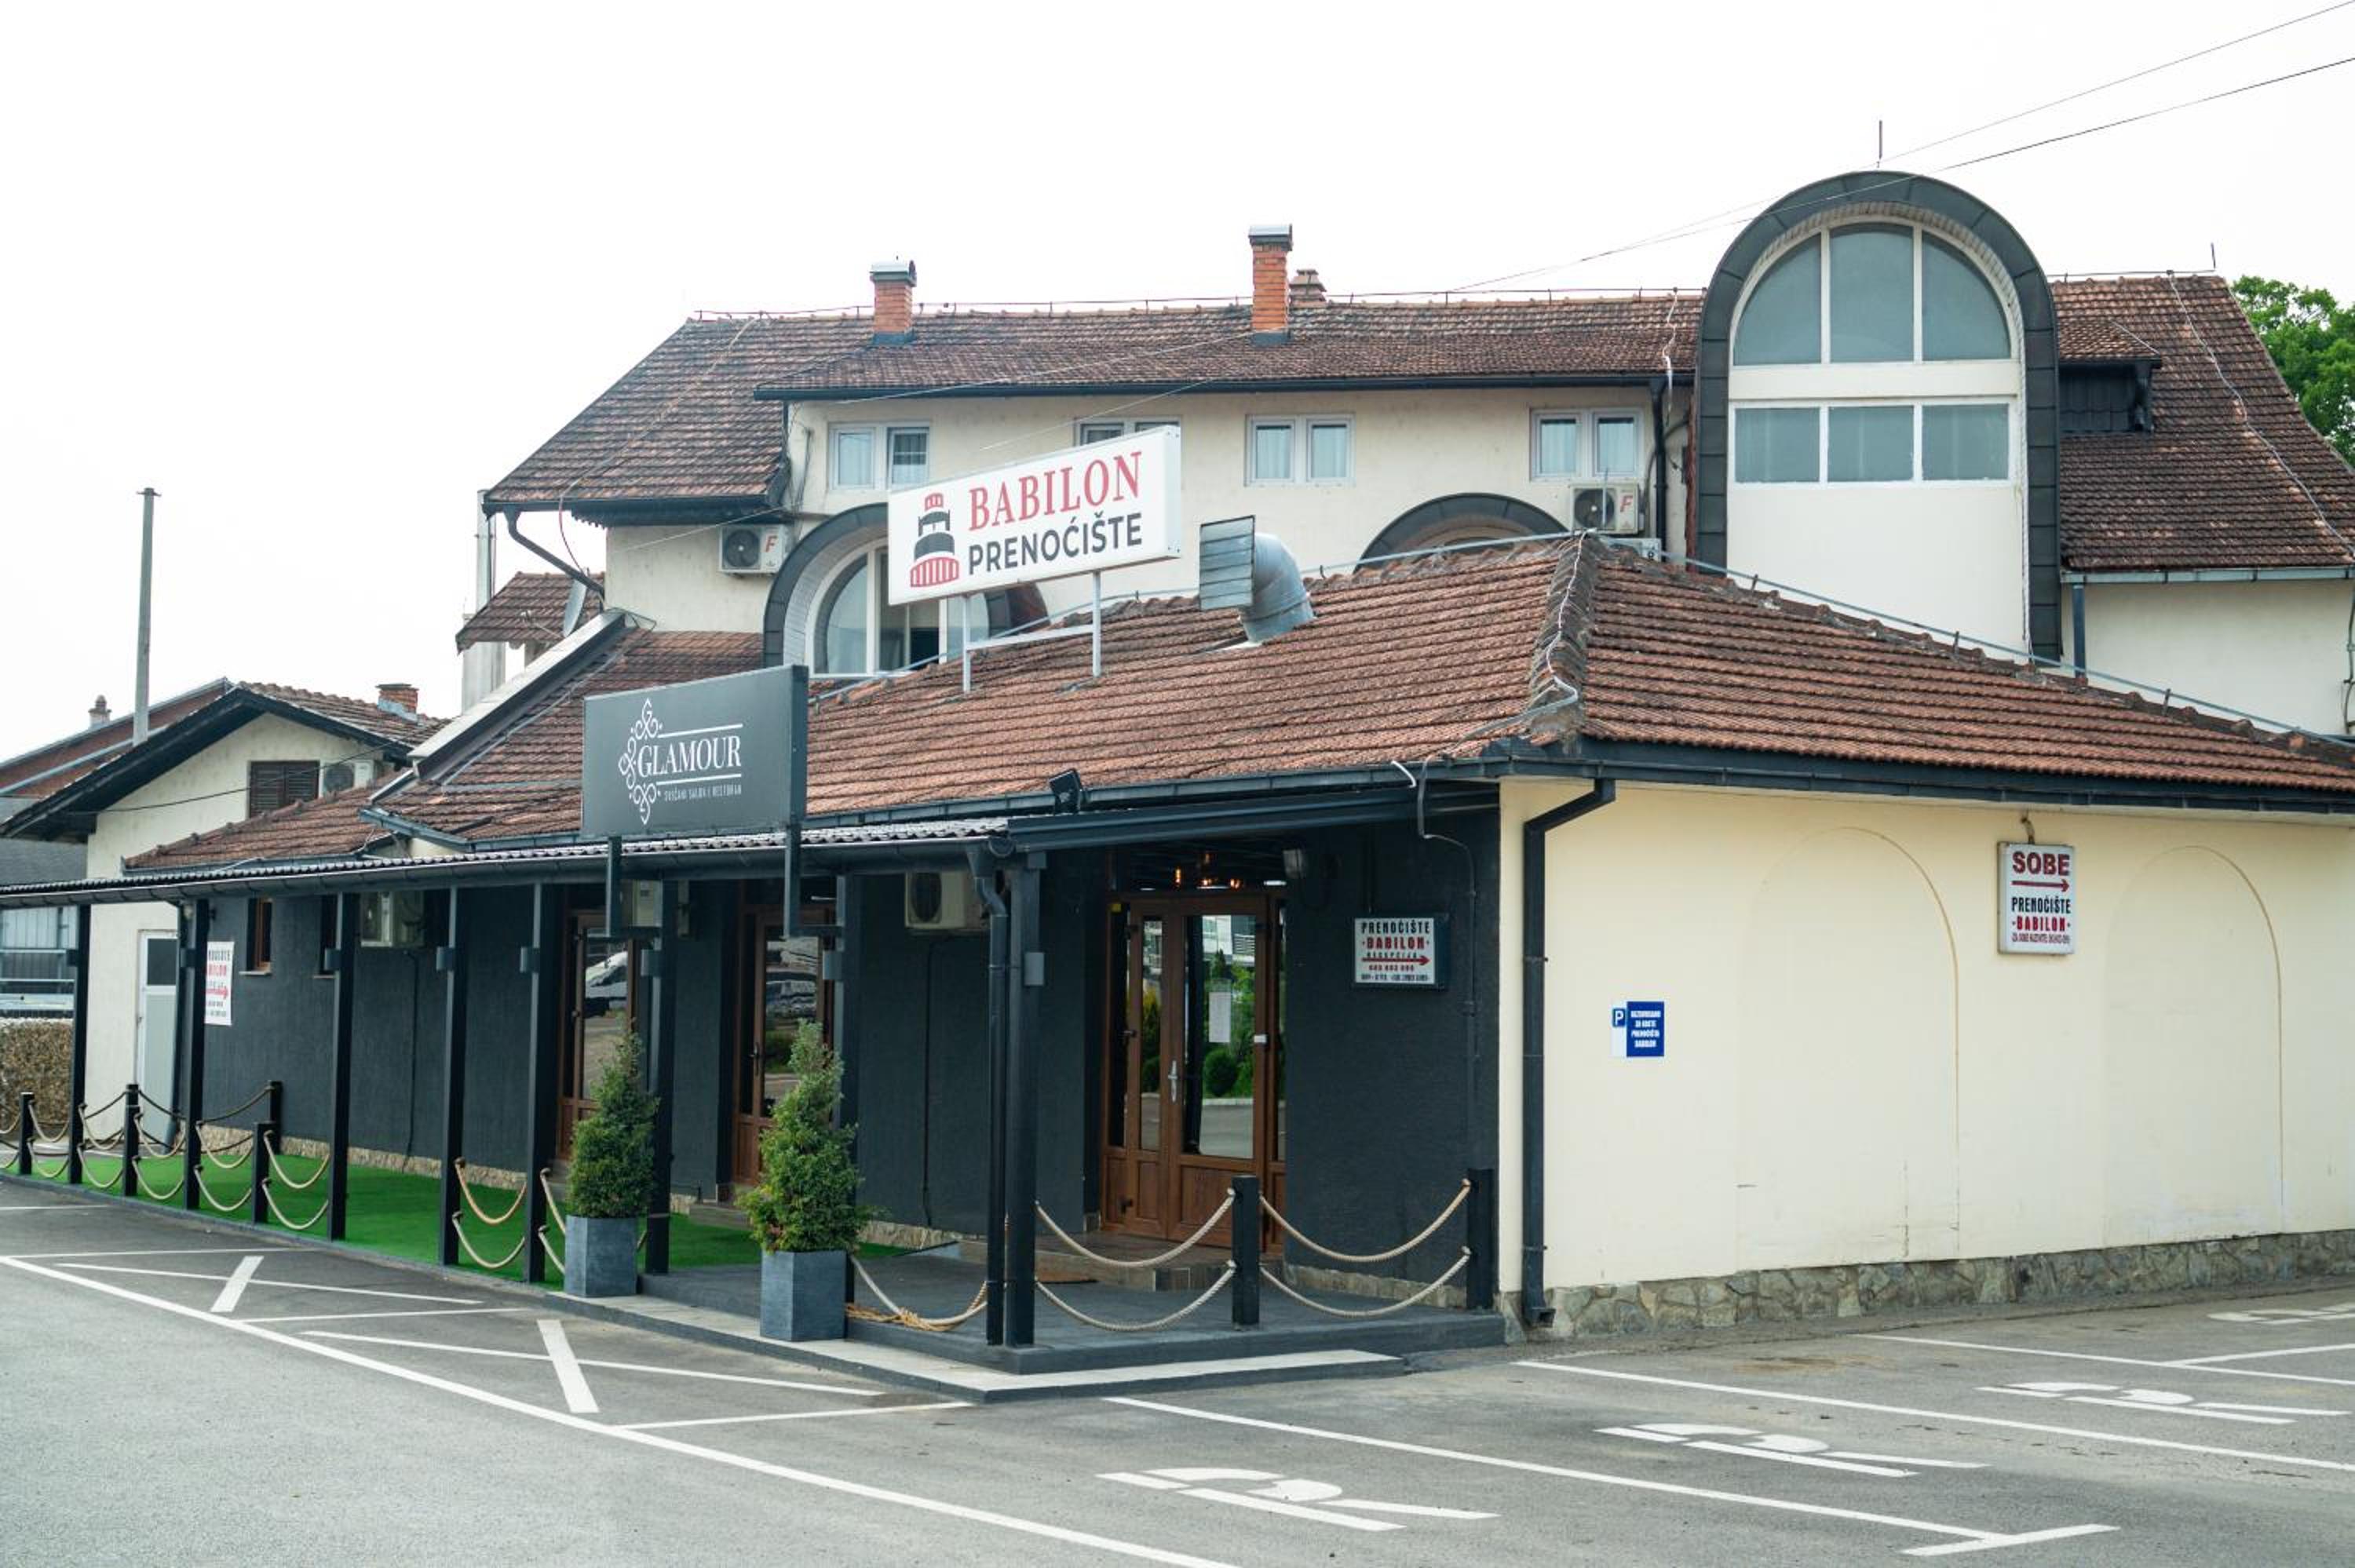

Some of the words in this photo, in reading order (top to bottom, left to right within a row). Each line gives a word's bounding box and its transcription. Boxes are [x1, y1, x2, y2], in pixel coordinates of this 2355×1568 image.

[969, 451, 1142, 531] BABILON
[969, 511, 1142, 575] PRENOĆIŠTE
[637, 735, 741, 777] GLAMOUR
[2012, 851, 2070, 876] SOBE
[2011, 895, 2071, 913] PRENOĆIŠTE
[1361, 920, 1429, 934] PRENOĆIŠTE
[1615, 1009, 1624, 1026] P
